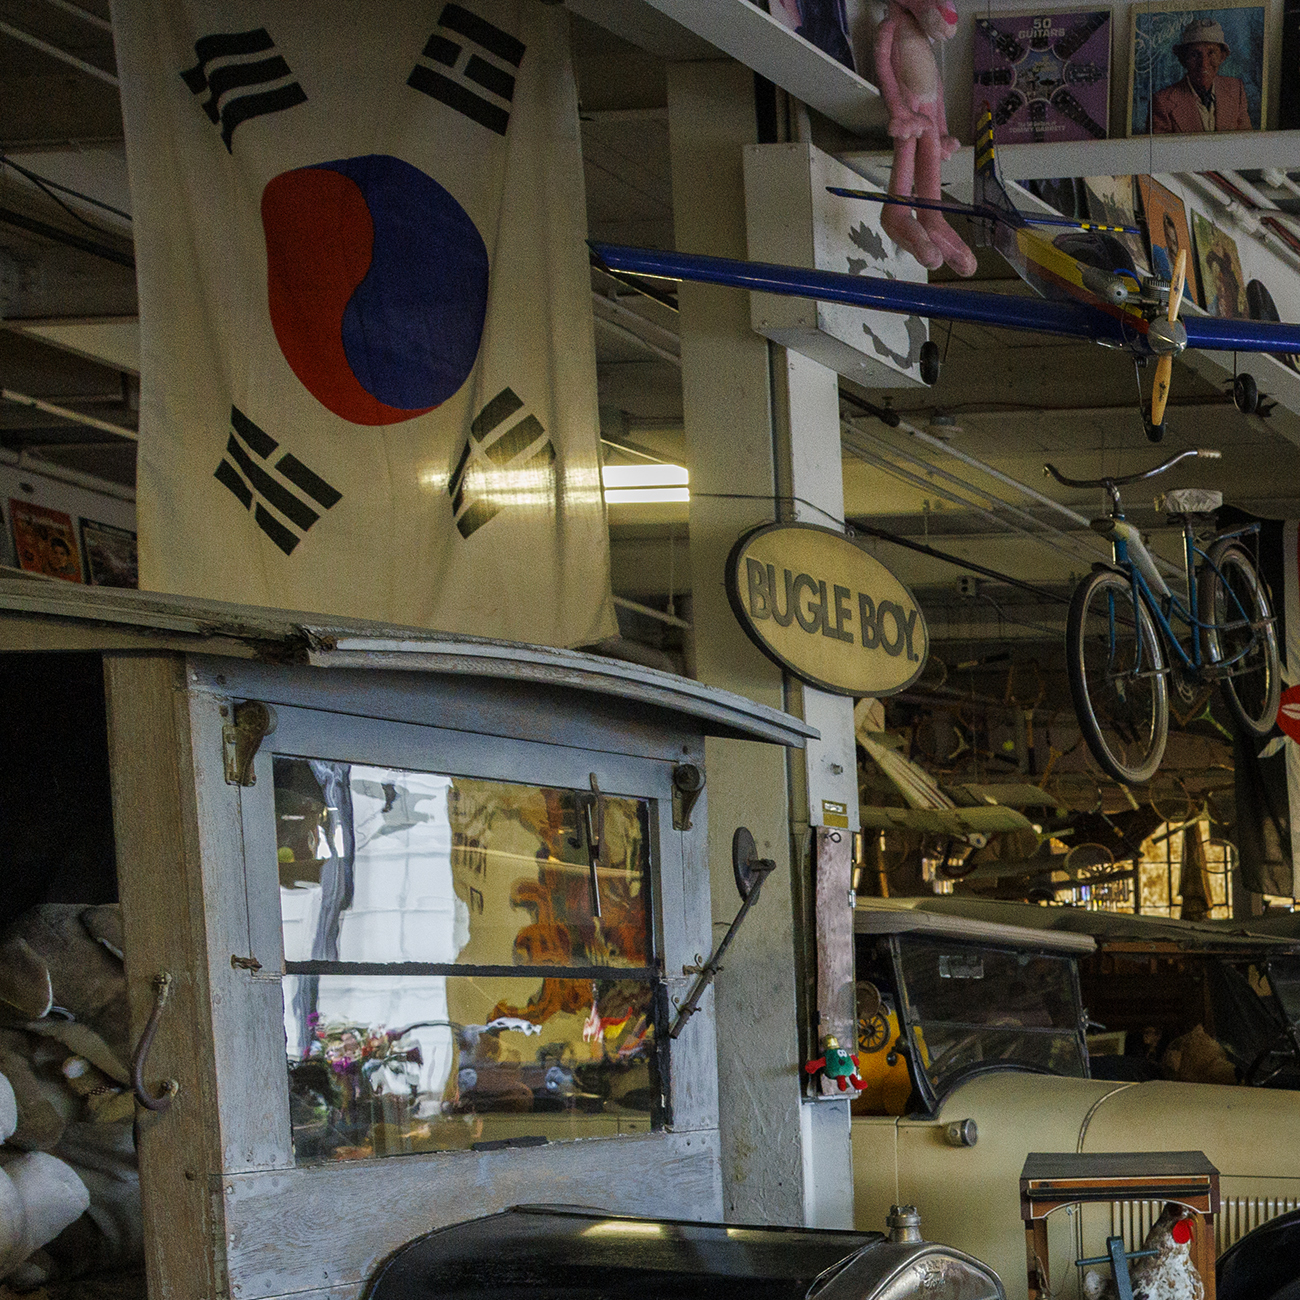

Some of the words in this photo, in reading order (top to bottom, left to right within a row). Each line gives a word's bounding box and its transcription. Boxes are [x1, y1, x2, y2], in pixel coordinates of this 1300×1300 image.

[1033, 18, 1052, 29] 50
[1018, 28, 1066, 39] GUITARS
[745, 557, 855, 644] BUGLE
